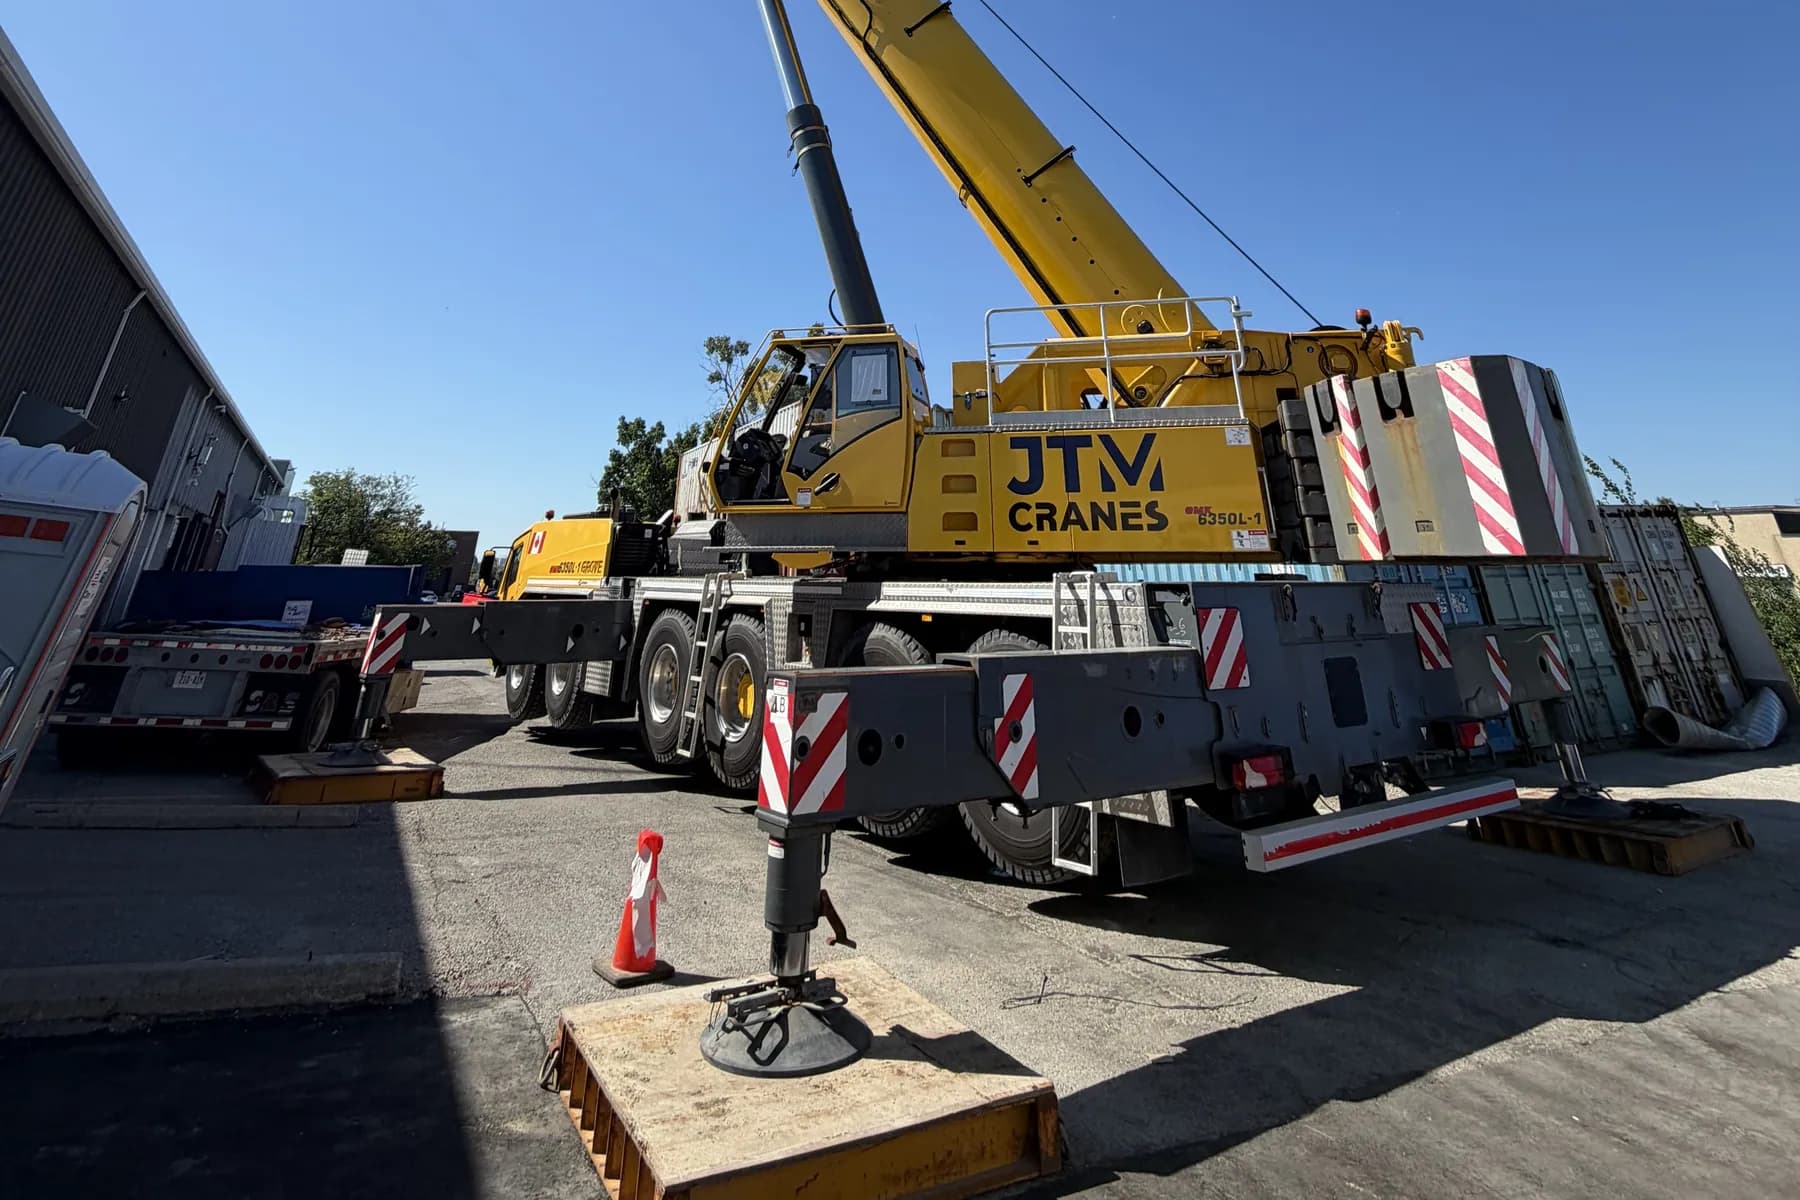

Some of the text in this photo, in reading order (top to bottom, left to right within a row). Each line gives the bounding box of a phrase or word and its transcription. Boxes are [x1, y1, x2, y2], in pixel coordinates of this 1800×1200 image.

[1007, 433, 1165, 496] JTM
[1008, 500, 1169, 532] CRANES
[1198, 512, 1262, 526] 6350L-1
